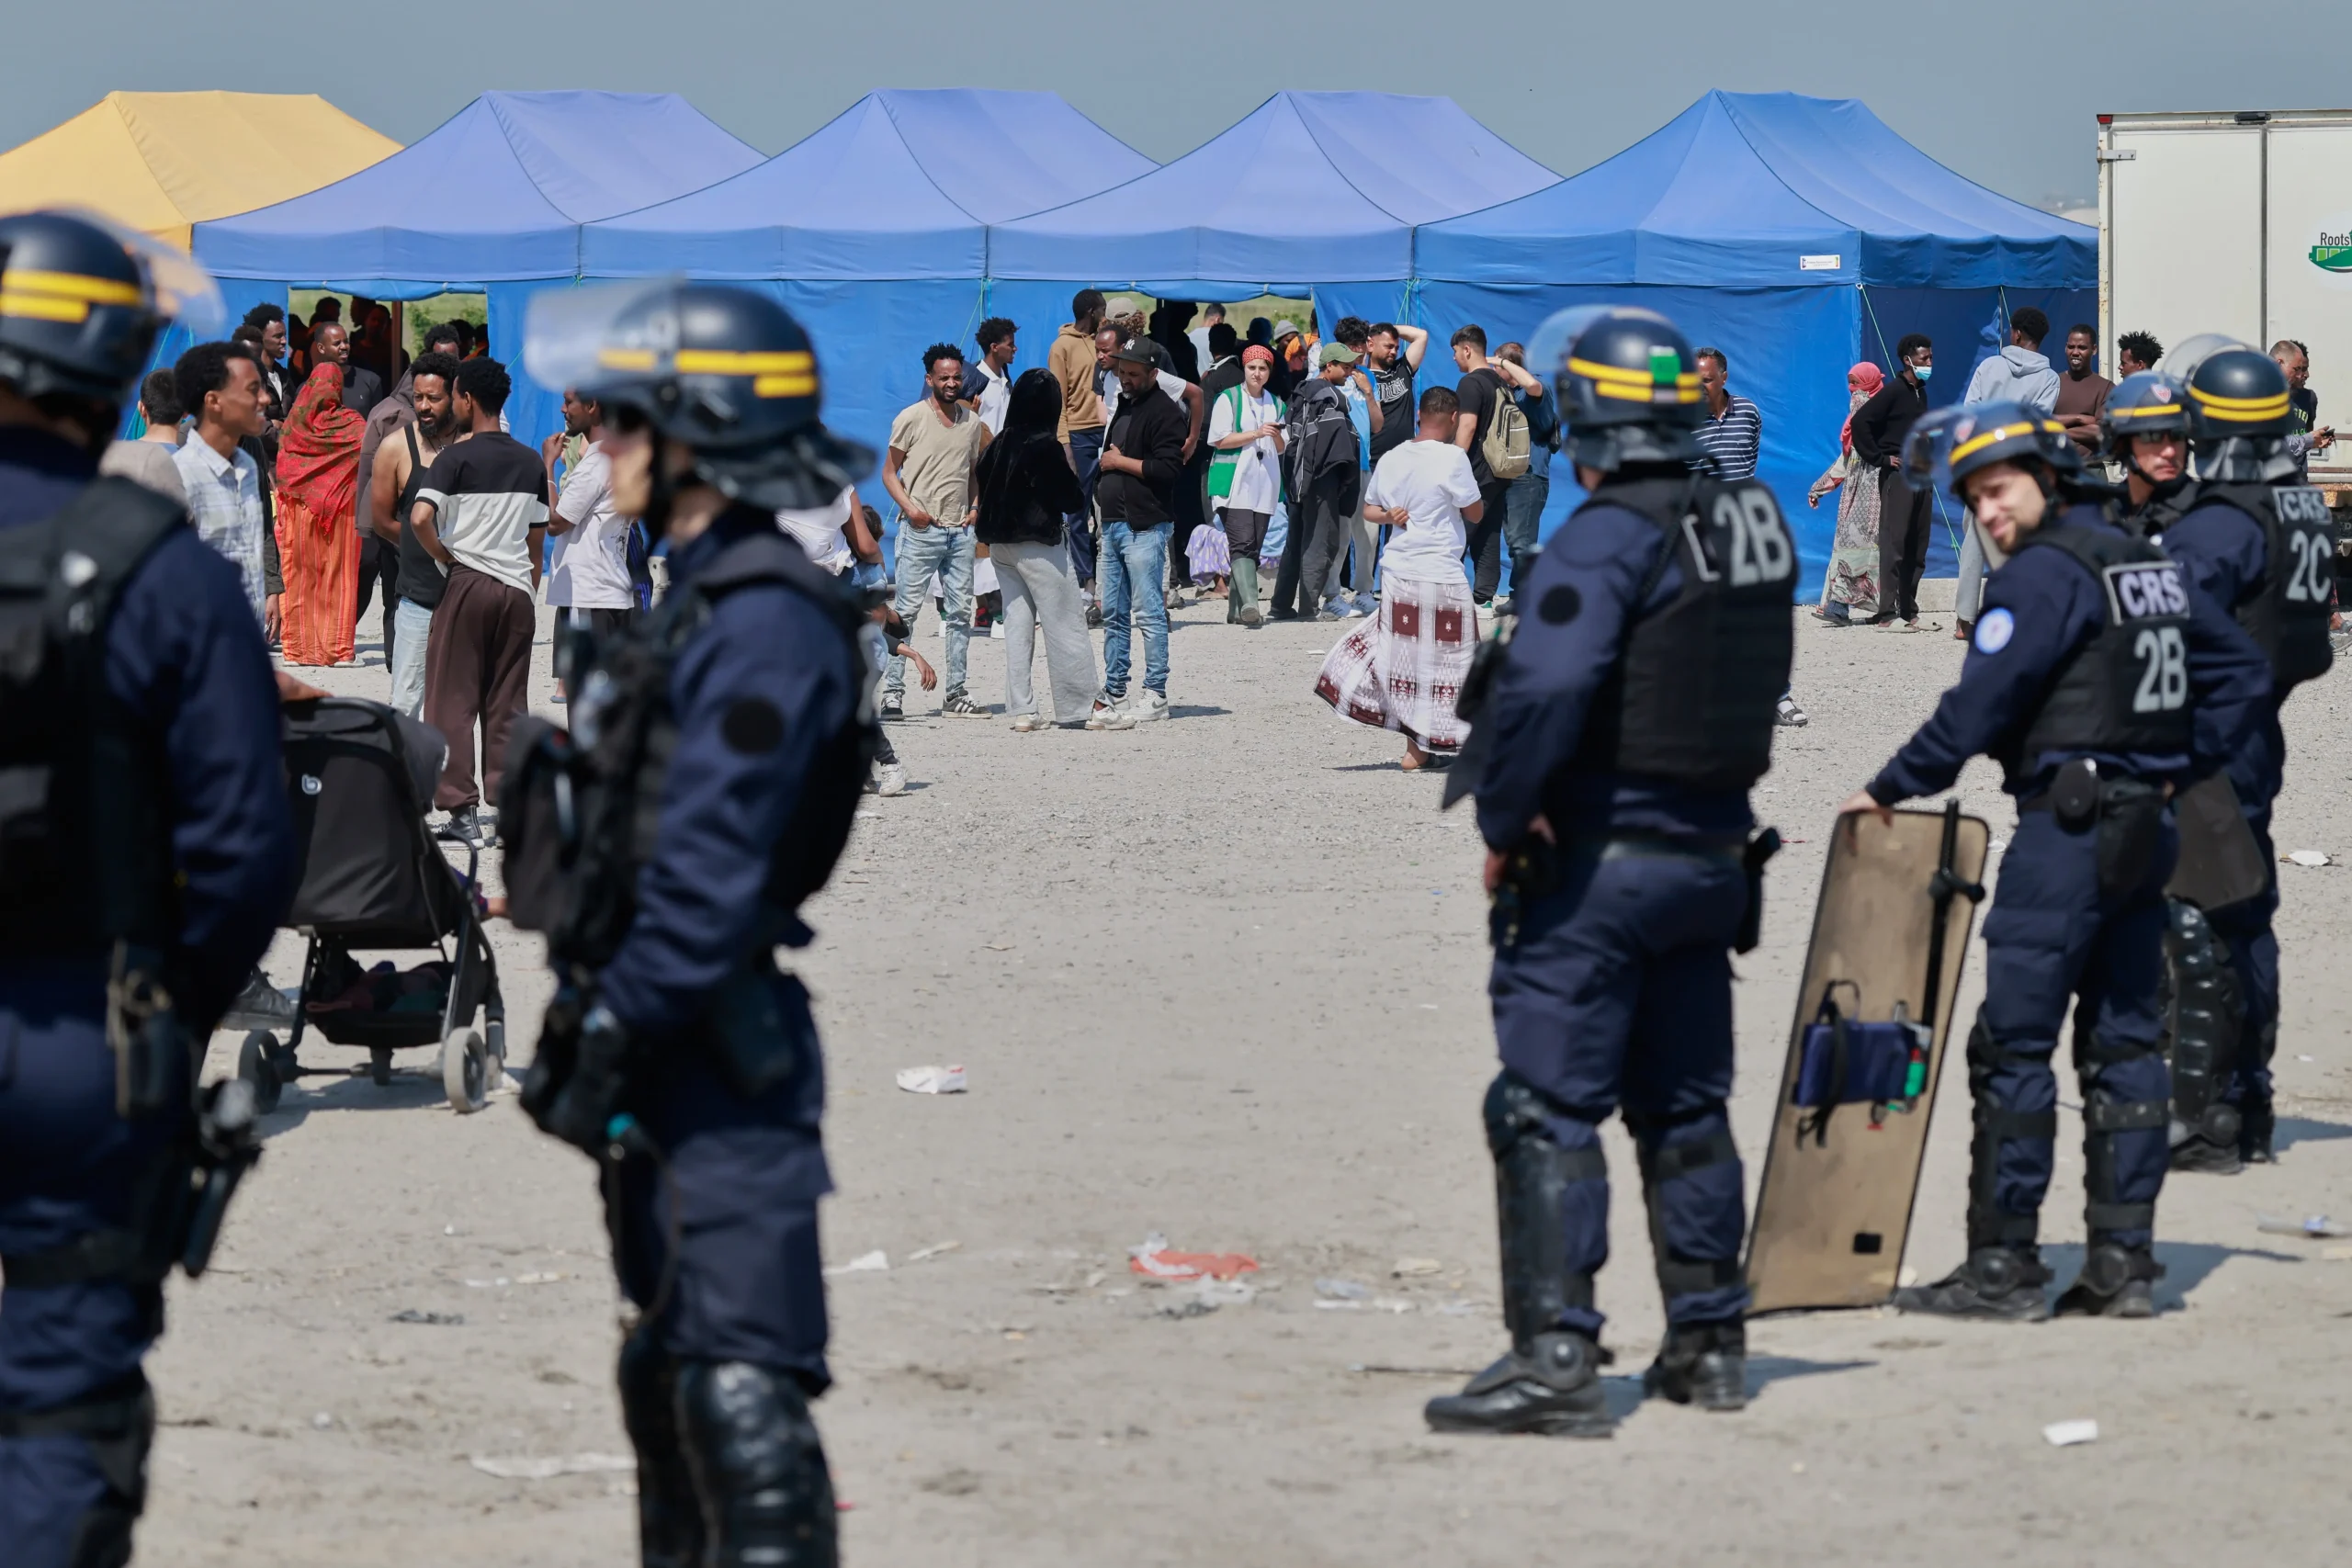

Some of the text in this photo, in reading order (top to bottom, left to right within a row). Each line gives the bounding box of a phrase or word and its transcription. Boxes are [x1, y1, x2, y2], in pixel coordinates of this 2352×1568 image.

[2320, 232, 2350, 246] Roots
[2283, 491, 2327, 521] CRS
[1713, 488, 1792, 586] 2B
[2286, 529, 2333, 603] 2C
[2119, 569, 2186, 617] CRS
[2132, 627, 2188, 713] 2B
